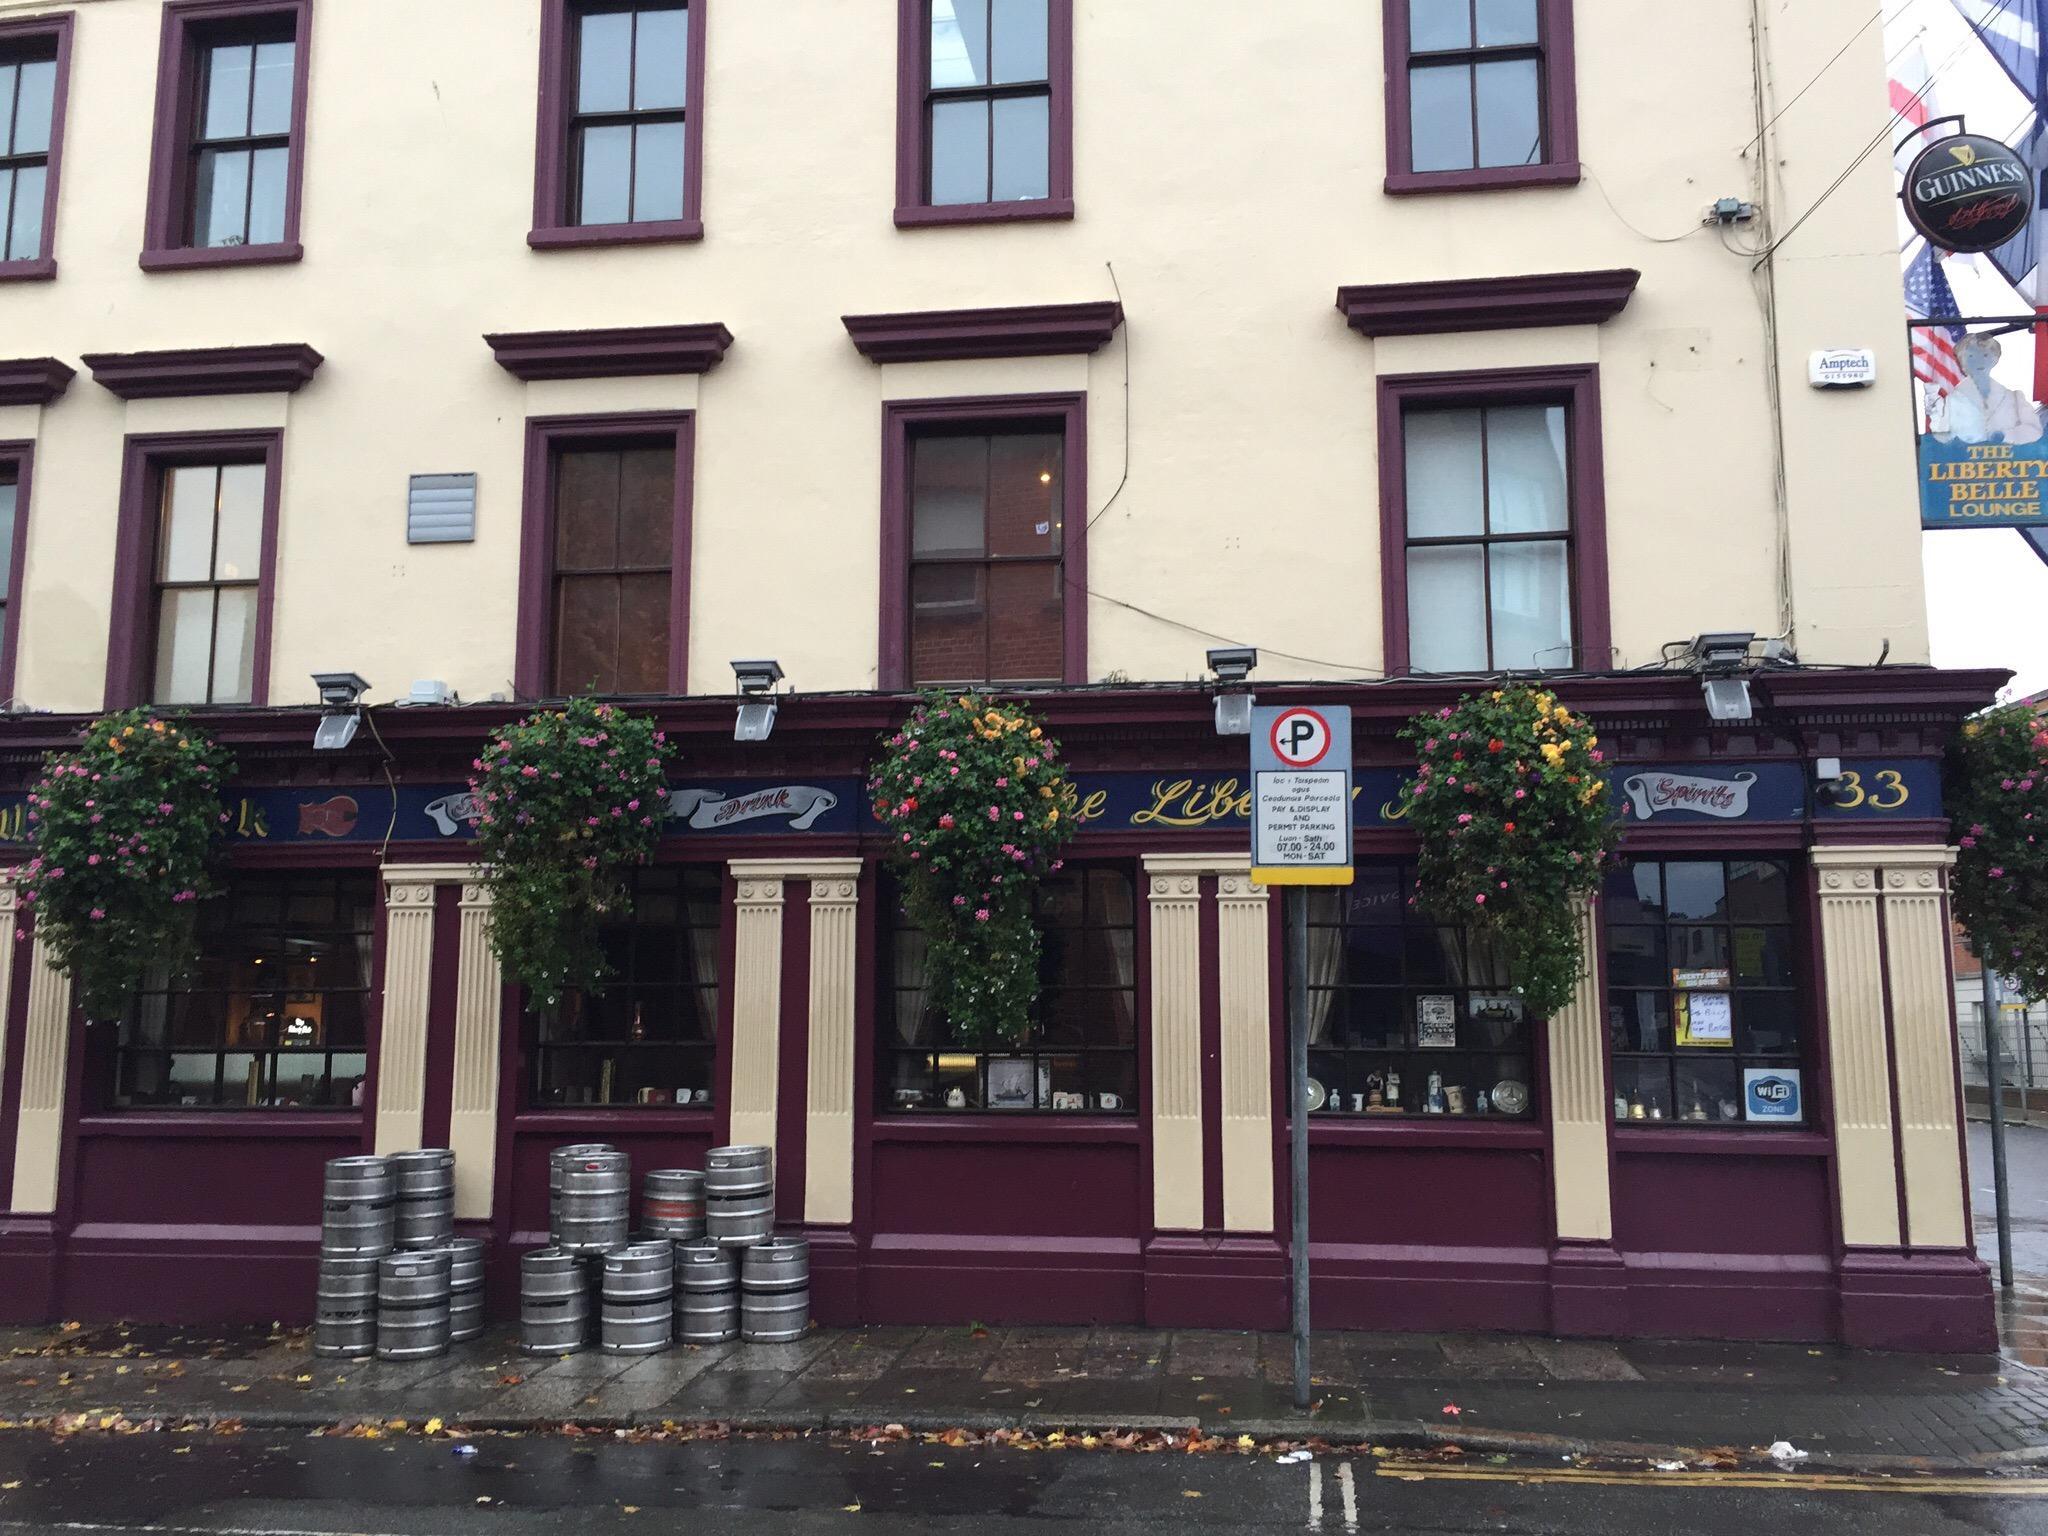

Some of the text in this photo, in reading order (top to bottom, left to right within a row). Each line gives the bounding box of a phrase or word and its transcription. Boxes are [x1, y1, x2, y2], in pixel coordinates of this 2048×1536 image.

[1915, 163, 2024, 202] GUINNESS
[1820, 356, 1869, 370] Amptech
[1967, 445, 2014, 460] THE
[1929, 460, 2048, 480] LIBERTY
[1949, 481, 2039, 501] BELLE
[1949, 502, 2042, 517] LOUNGE
[1291, 720, 1315, 756] P
[1653, 778, 1736, 809] Spirits
[1835, 770, 1909, 808] 33
[714, 789, 792, 823] Drink
[1062, 782, 1107, 819] he
[1277, 843, 1301, 852] 07.00
[1310, 842, 1335, 851] 24.00
[1762, 1105, 1785, 1113] ZONE
